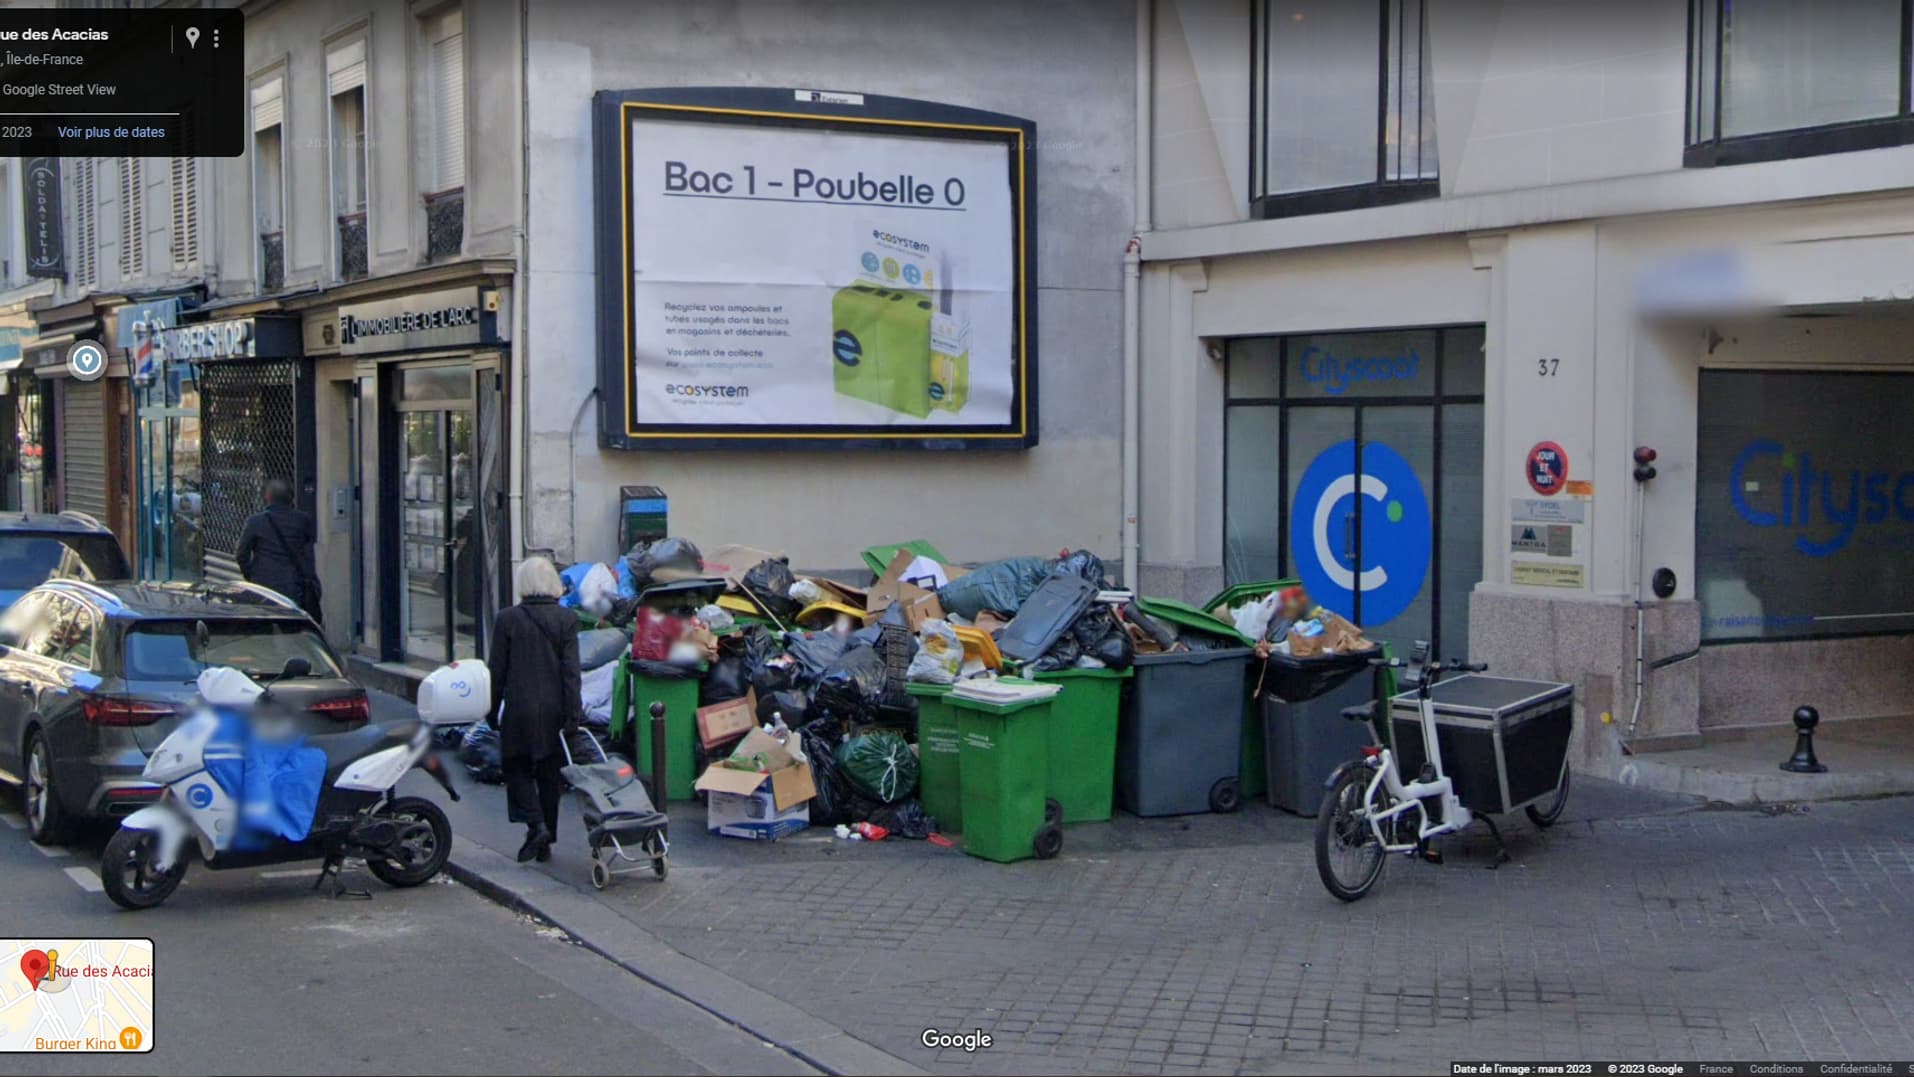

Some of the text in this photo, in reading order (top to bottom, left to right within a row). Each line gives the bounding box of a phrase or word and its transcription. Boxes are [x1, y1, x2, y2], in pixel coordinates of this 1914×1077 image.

[664, 161, 734, 194] Bac
[743, 165, 755, 195] 1
[793, 168, 935, 205] Poubelle
[943, 177, 966, 206] 0
[872, 229, 930, 254] ecosystem
[664, 302, 783, 314] Recyclez vos ampoules et
[423, 312, 439, 329] DE
[664, 315, 690, 324] tubes
[727, 315, 751, 324] dans
[752, 316, 765, 325] les
[767, 316, 790, 325] bacs
[206, 320, 248, 357] SHOP
[678, 327, 721, 338] magasins
[723, 327, 734, 336] et
[667, 347, 764, 358] Vos points de collecte
[1301, 346, 1420, 396] Cityscoot
[1538, 358, 1560, 377] 37
[664, 383, 750, 398] ecosystem
[1535, 451, 1556, 461] JOUR
[1539, 463, 1550, 473] ET
[1535, 475, 1553, 485] NUIT
